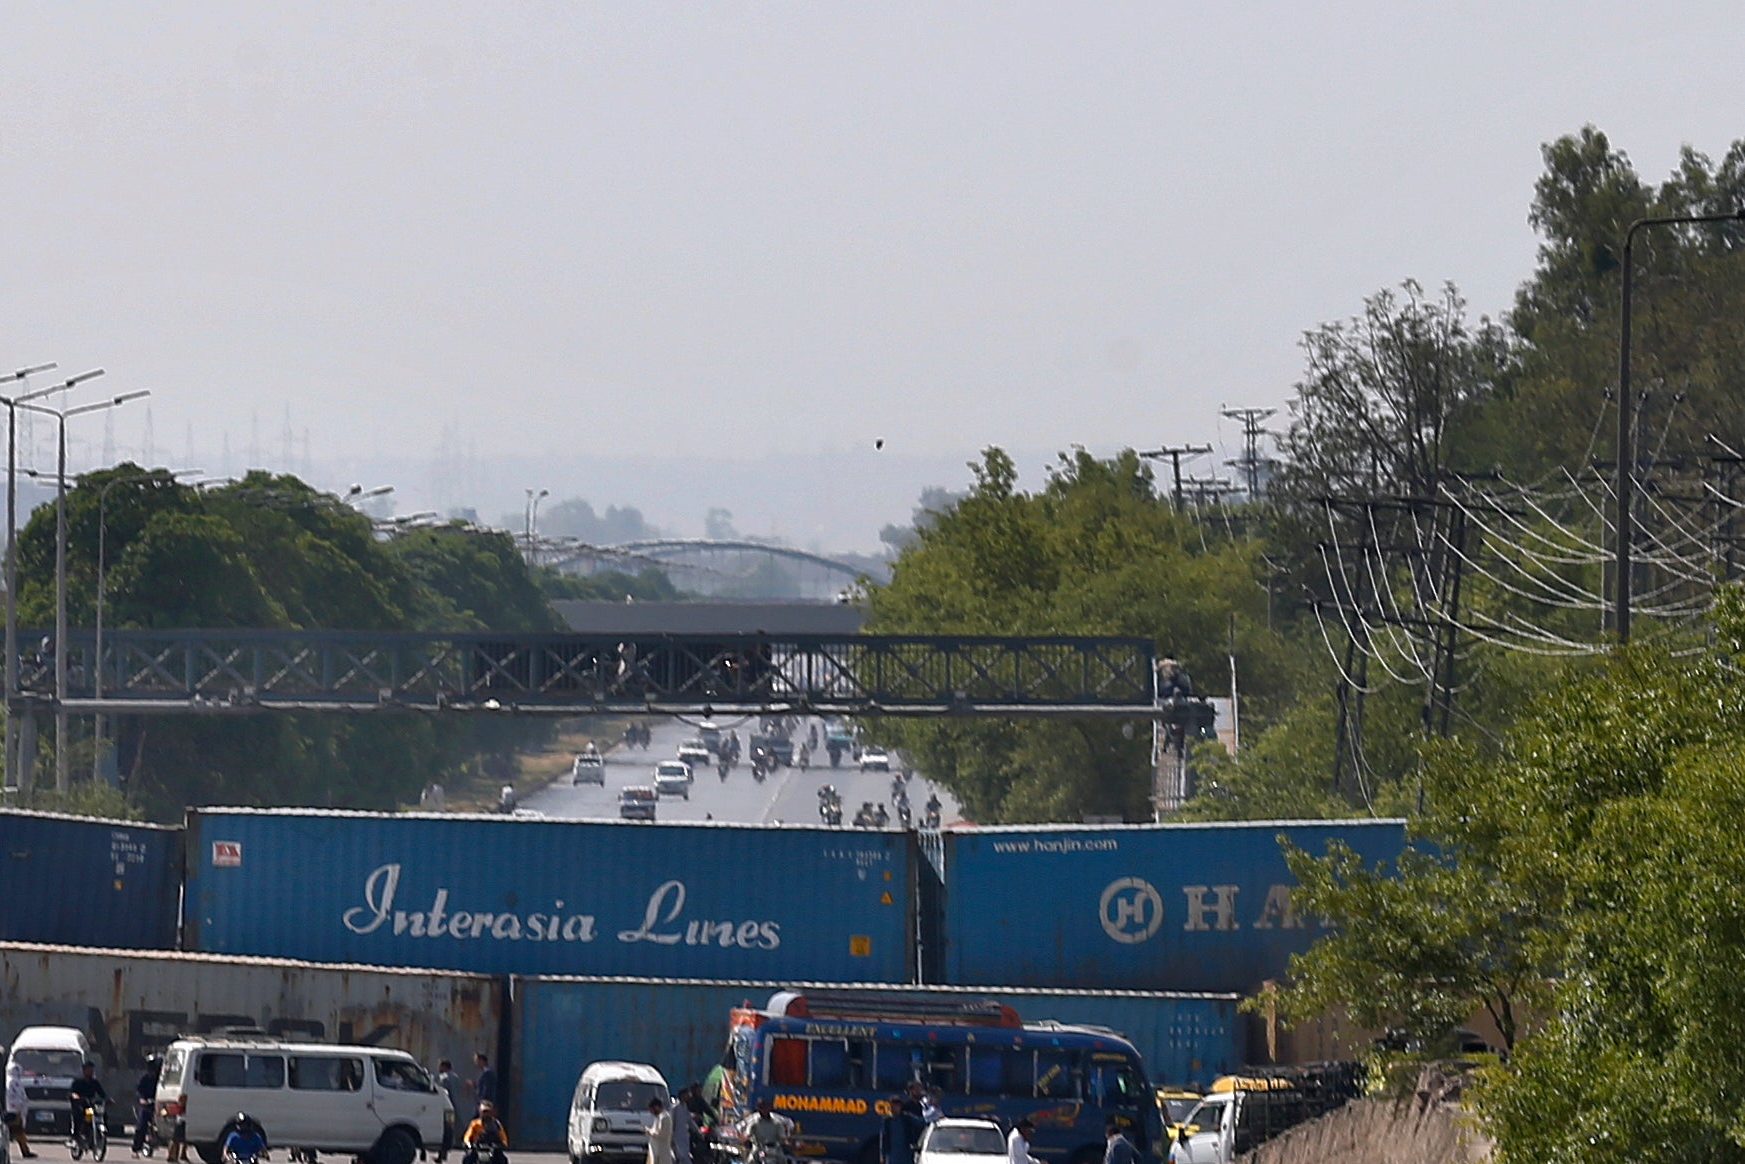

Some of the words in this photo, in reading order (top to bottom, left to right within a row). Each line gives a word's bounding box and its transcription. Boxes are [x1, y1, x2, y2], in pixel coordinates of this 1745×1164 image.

[342, 863, 597, 942] Interasia
[617, 880, 781, 949] Lines
[773, 1094, 868, 1115] MOHAMMAD
